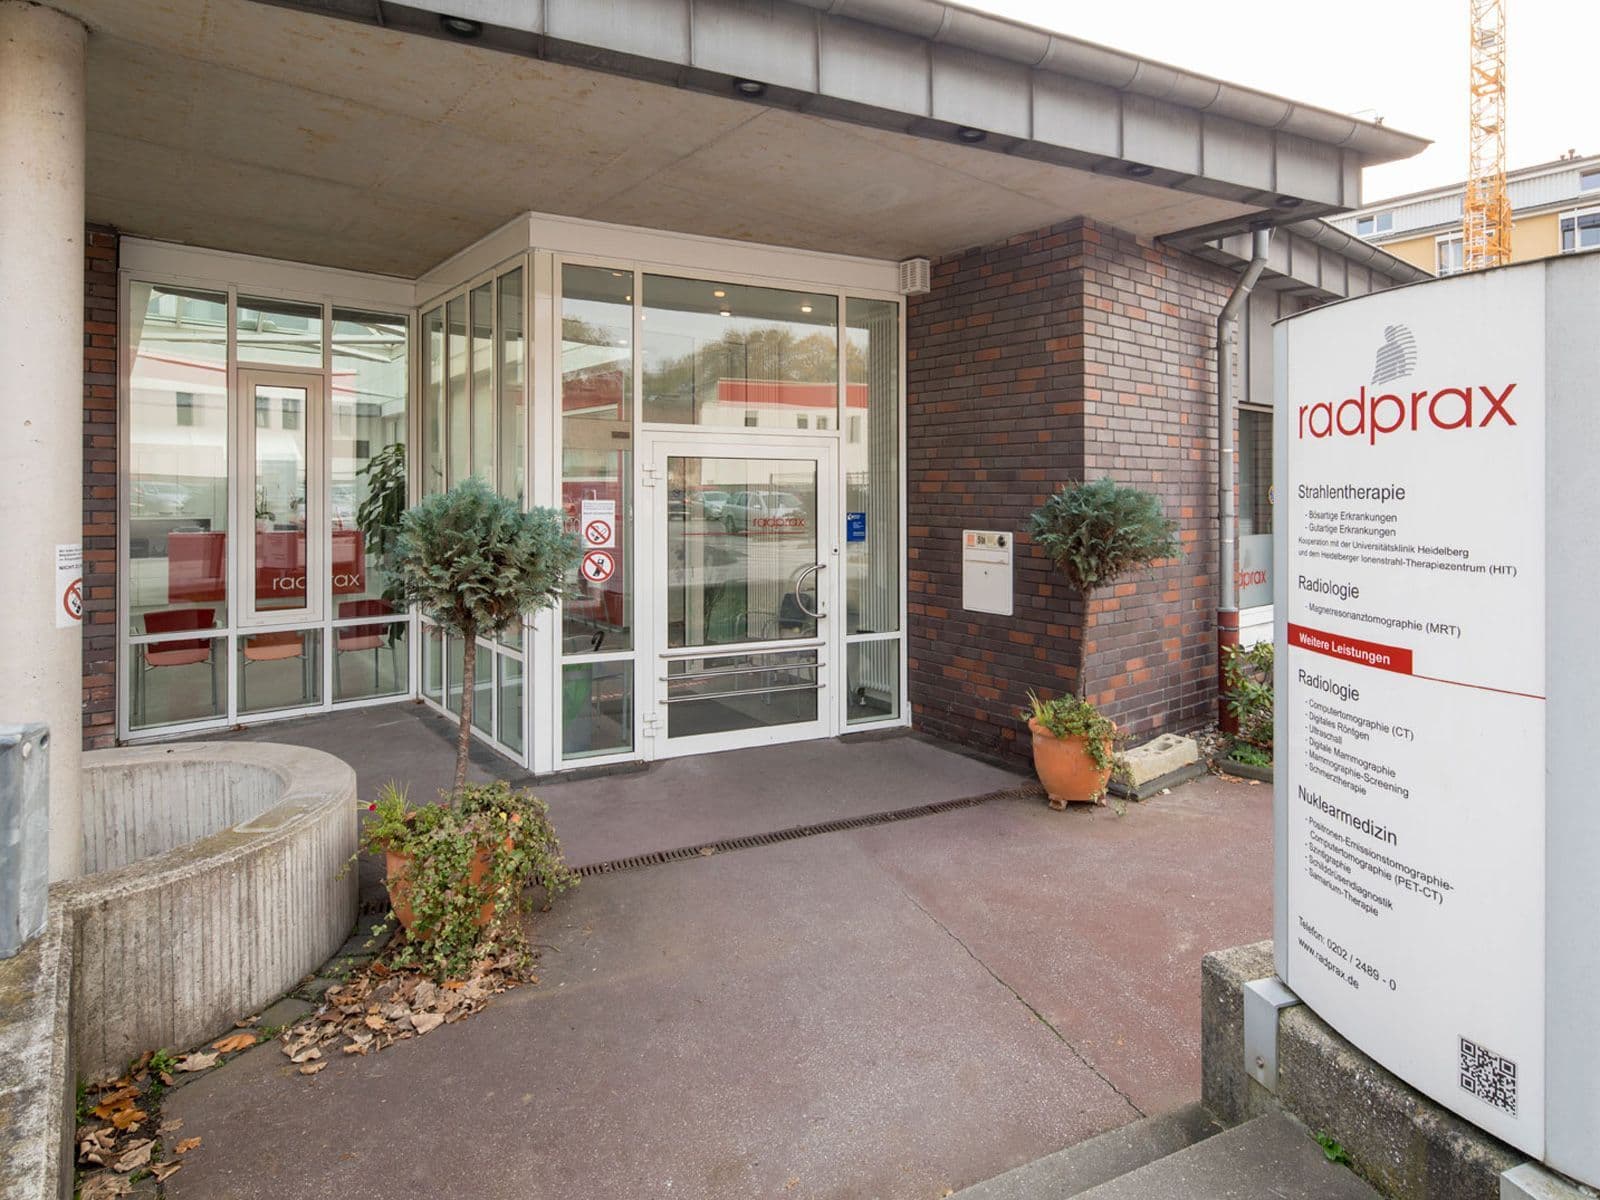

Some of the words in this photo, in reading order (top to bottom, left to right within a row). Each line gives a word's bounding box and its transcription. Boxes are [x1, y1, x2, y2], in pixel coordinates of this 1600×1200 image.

[1299, 384, 1517, 445] radprax
[1298, 484, 1405, 503] Strahlentherapie
[1308, 510, 1338, 521] Bösartige
[1340, 511, 1398, 524] Erkrankungen
[1308, 523, 1338, 534] Gutartige
[1339, 525, 1397, 538] Erkrankungen
[1298, 549, 1308, 557] und
[1308, 550, 1320, 558] dem
[1321, 552, 1359, 563] Heidelberger
[1361, 554, 1486, 573] Ionenstrahl-Therapiezentrum
[1489, 565, 1518, 578] (HIT)
[1330, 539, 1340, 547] mit
[1340, 540, 1351, 549] der
[1352, 541, 1415, 553] Universitätsklinik
[1417, 545, 1470, 559] Heidelberg
[1298, 575, 1360, 600] Radiologie
[1309, 602, 1422, 632] Magnetresonanztomographie
[1425, 622, 1461, 639] (MRT)
[1299, 632, 1330, 651] Weitere
[1331, 641, 1391, 665] Leistungen
[1298, 669, 1360, 702] Radiologie
[1309, 699, 1389, 734] Computertomographie
[1391, 725, 1415, 742] (CT)
[1309, 711, 1336, 729] Digitales
[1337, 721, 1370, 741] Röntgen
[1309, 724, 1343, 745] Ultraschall
[1309, 736, 1332, 754] Digitale
[1333, 747, 1396, 778] Mammographie
[1309, 749, 1409, 798] Mammographie-Screening
[1309, 762, 1367, 795] Schmerztherapie
[1298, 784, 1398, 846] Nuklearmedizin
[1309, 816, 1455, 891] Positronen-Emissionstomographie-
[1309, 842, 1351, 874] Szintigraphie
[1309, 830, 1392, 881] Computertomographie
[1394, 874, 1444, 905] (PET-CT)
[1309, 854, 1393, 910] Schilddrüsendiagnostik
[1309, 867, 1379, 917] Samarium-Therapie
[1298, 915, 1325, 944] Telefon:
[1326, 938, 1348, 961] 0202
[1355, 957, 1380, 981] 2489
[1389, 978, 1397, 991] 0
[1298, 937, 1359, 989] www.radprax.de
